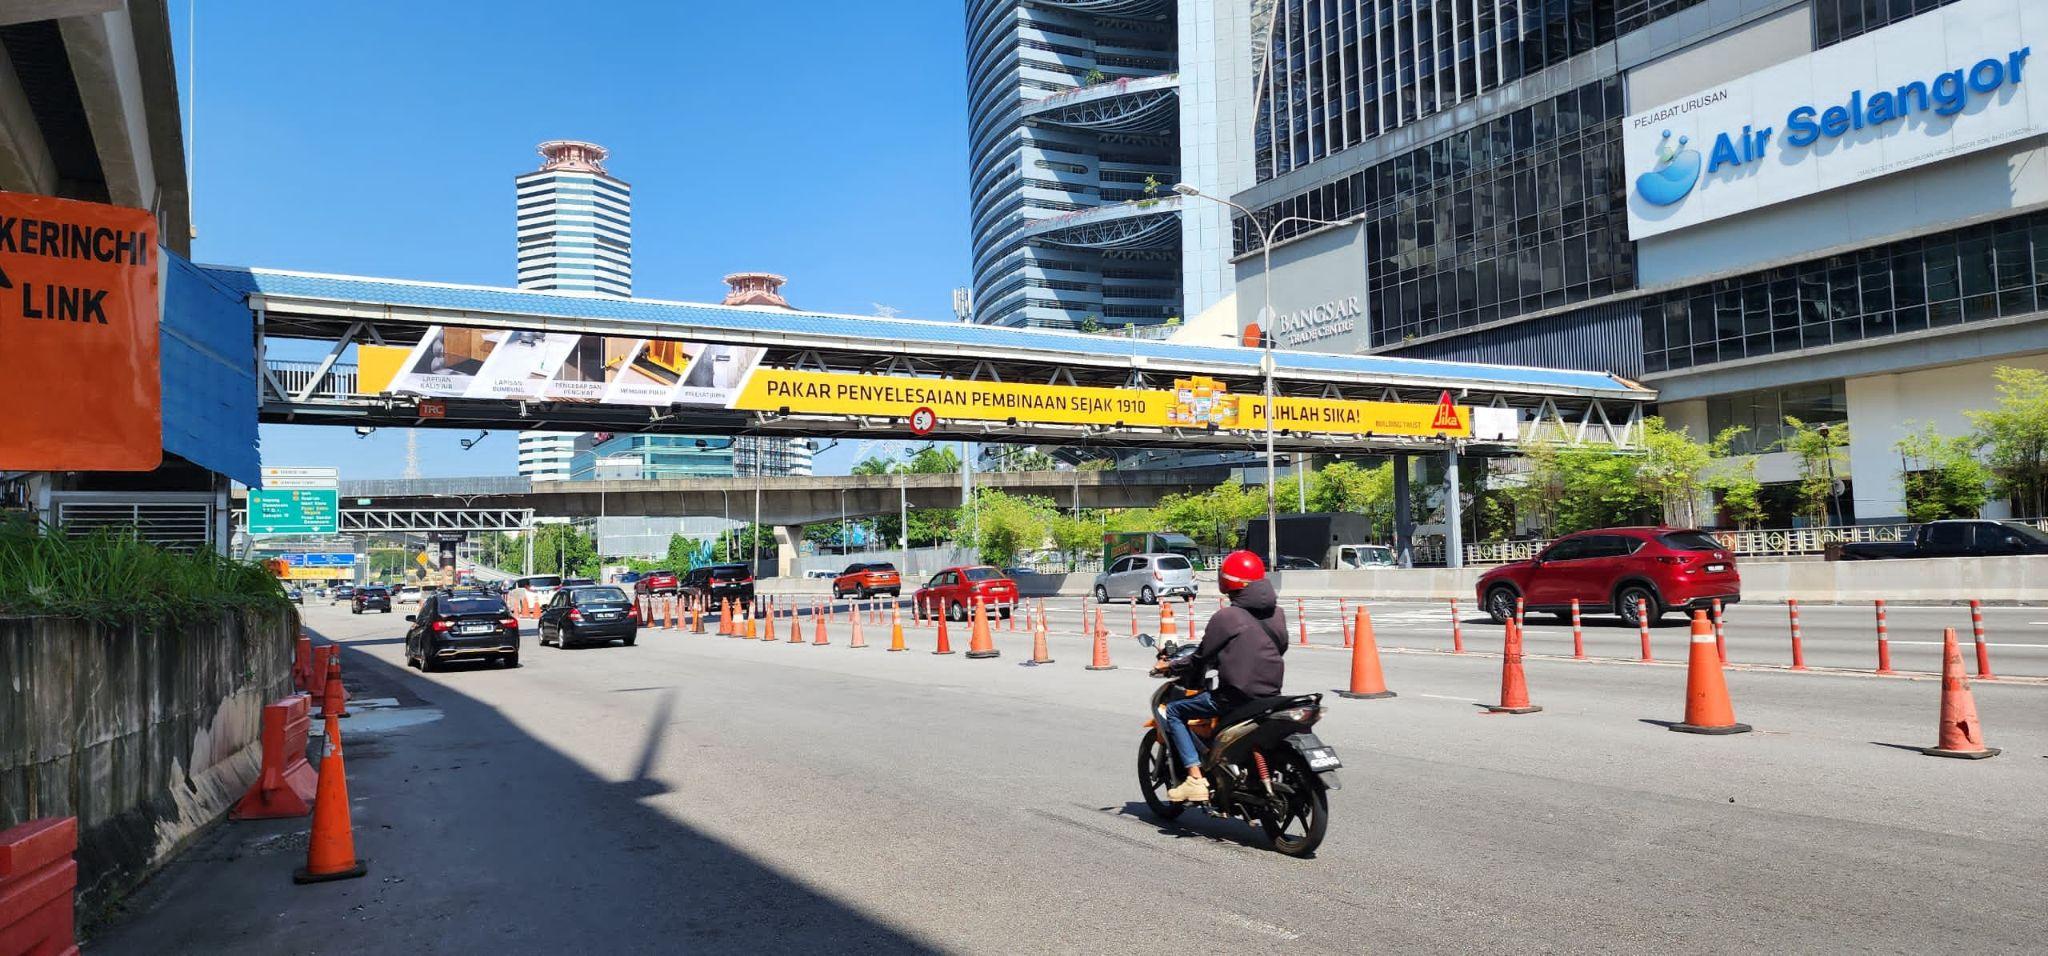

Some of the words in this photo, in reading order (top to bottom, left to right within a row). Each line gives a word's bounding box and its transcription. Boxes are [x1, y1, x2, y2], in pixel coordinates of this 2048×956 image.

[1634, 106, 1681, 129] PEJABAT
[1681, 89, 1728, 115] URUSAN
[1708, 125, 1773, 174] Air
[1787, 46, 2030, 147] Selangor
[0, 215, 147, 266] KERINCHI
[23, 283, 109, 325] LINK
[1280, 297, 1360, 332] BANGSAR
[1289, 329, 1317, 345] TRADE
[1318, 320, 1354, 338] CENTRE
[422, 404, 443, 414] TRC
[767, 380, 831, 399] PAKAR
[837, 385, 967, 406] PENYELESAIAN
[972, 392, 1066, 410] PEMBINAAN
[1070, 396, 1113, 413] SEJAK
[1116, 399, 1146, 413] 1910
[1324, 407, 1360, 423] SIKA!
[1435, 404, 1458, 426] Sika
